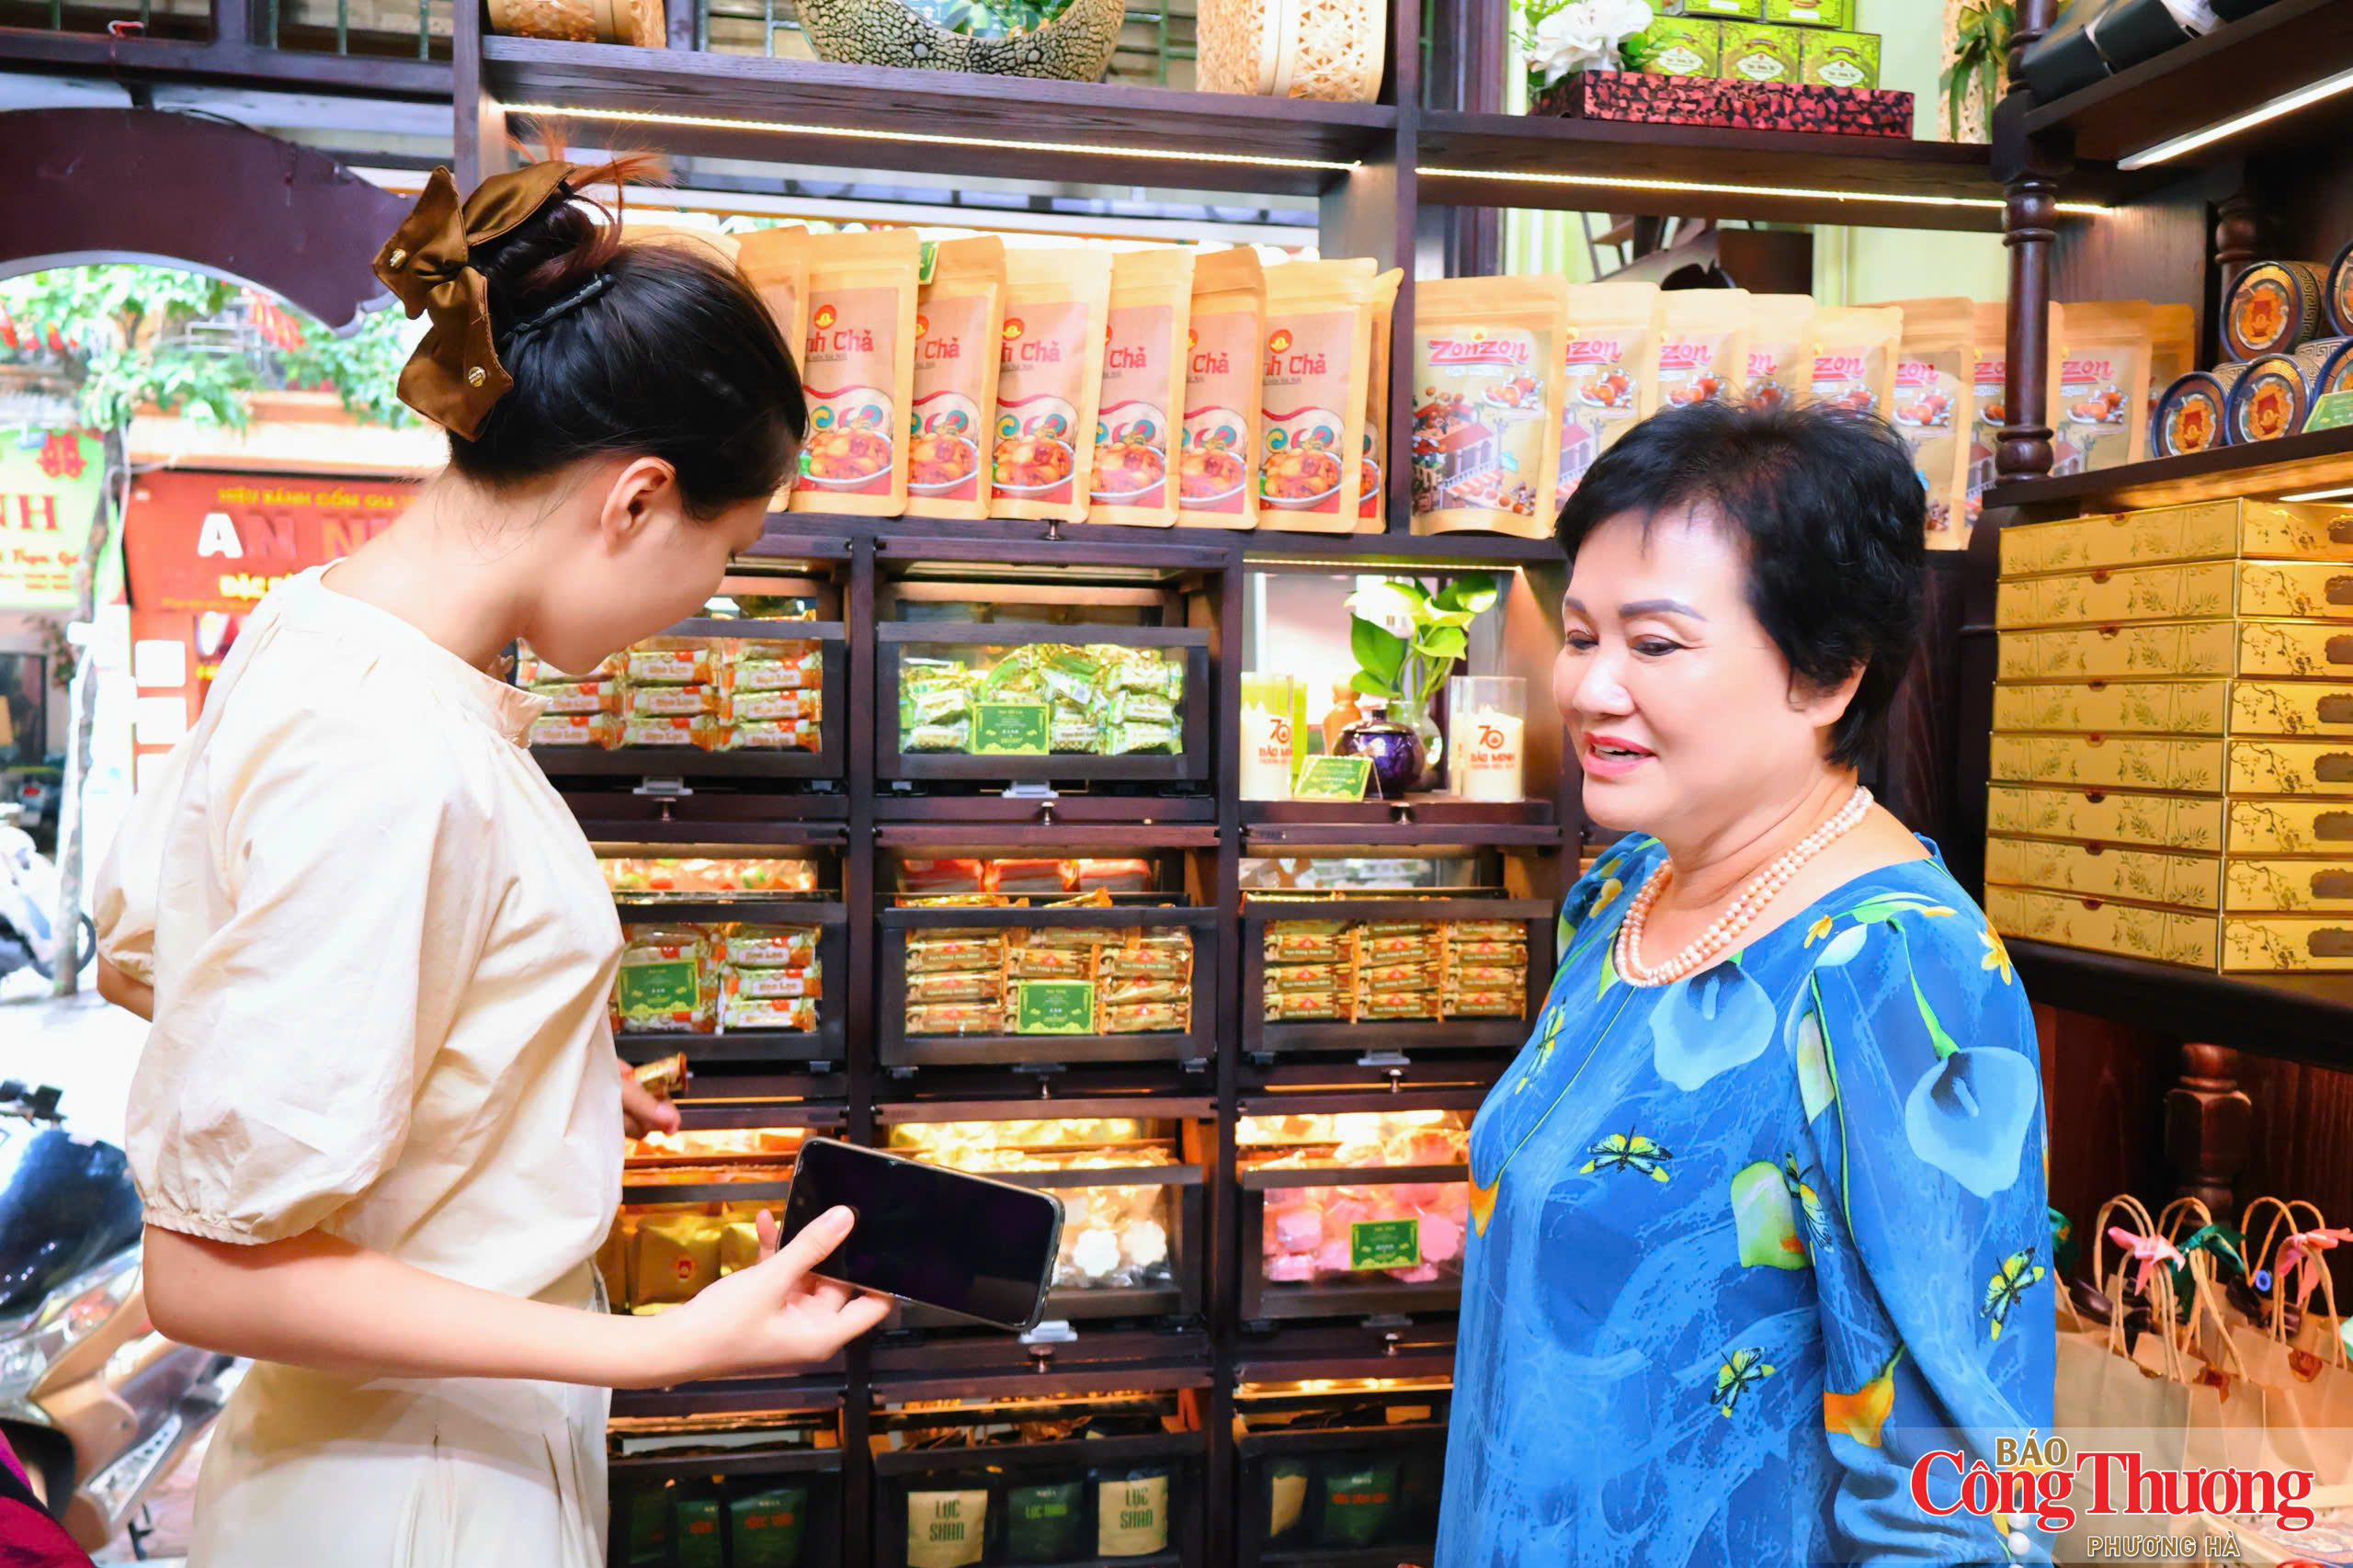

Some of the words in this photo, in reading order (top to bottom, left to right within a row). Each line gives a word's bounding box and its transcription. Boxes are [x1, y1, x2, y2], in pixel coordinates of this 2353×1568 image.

[806, 332, 825, 352] nh
[834, 329, 873, 352] Chả
[925, 337, 960, 359] Chả
[1020, 341, 1060, 362] Chả
[1427, 338, 1529, 365] Zonzon
[1565, 339, 1622, 364] zon
[1109, 347, 1147, 369] Chả
[1192, 352, 1230, 374] Chả
[1264, 355, 1281, 376] nh
[1289, 353, 1326, 375] Chả
[1659, 344, 1712, 368] zon
[1812, 356, 1865, 380] zon
[2061, 359, 2114, 382] zon
[197, 511, 297, 560] AN
[1477, 724, 1505, 749] 70
